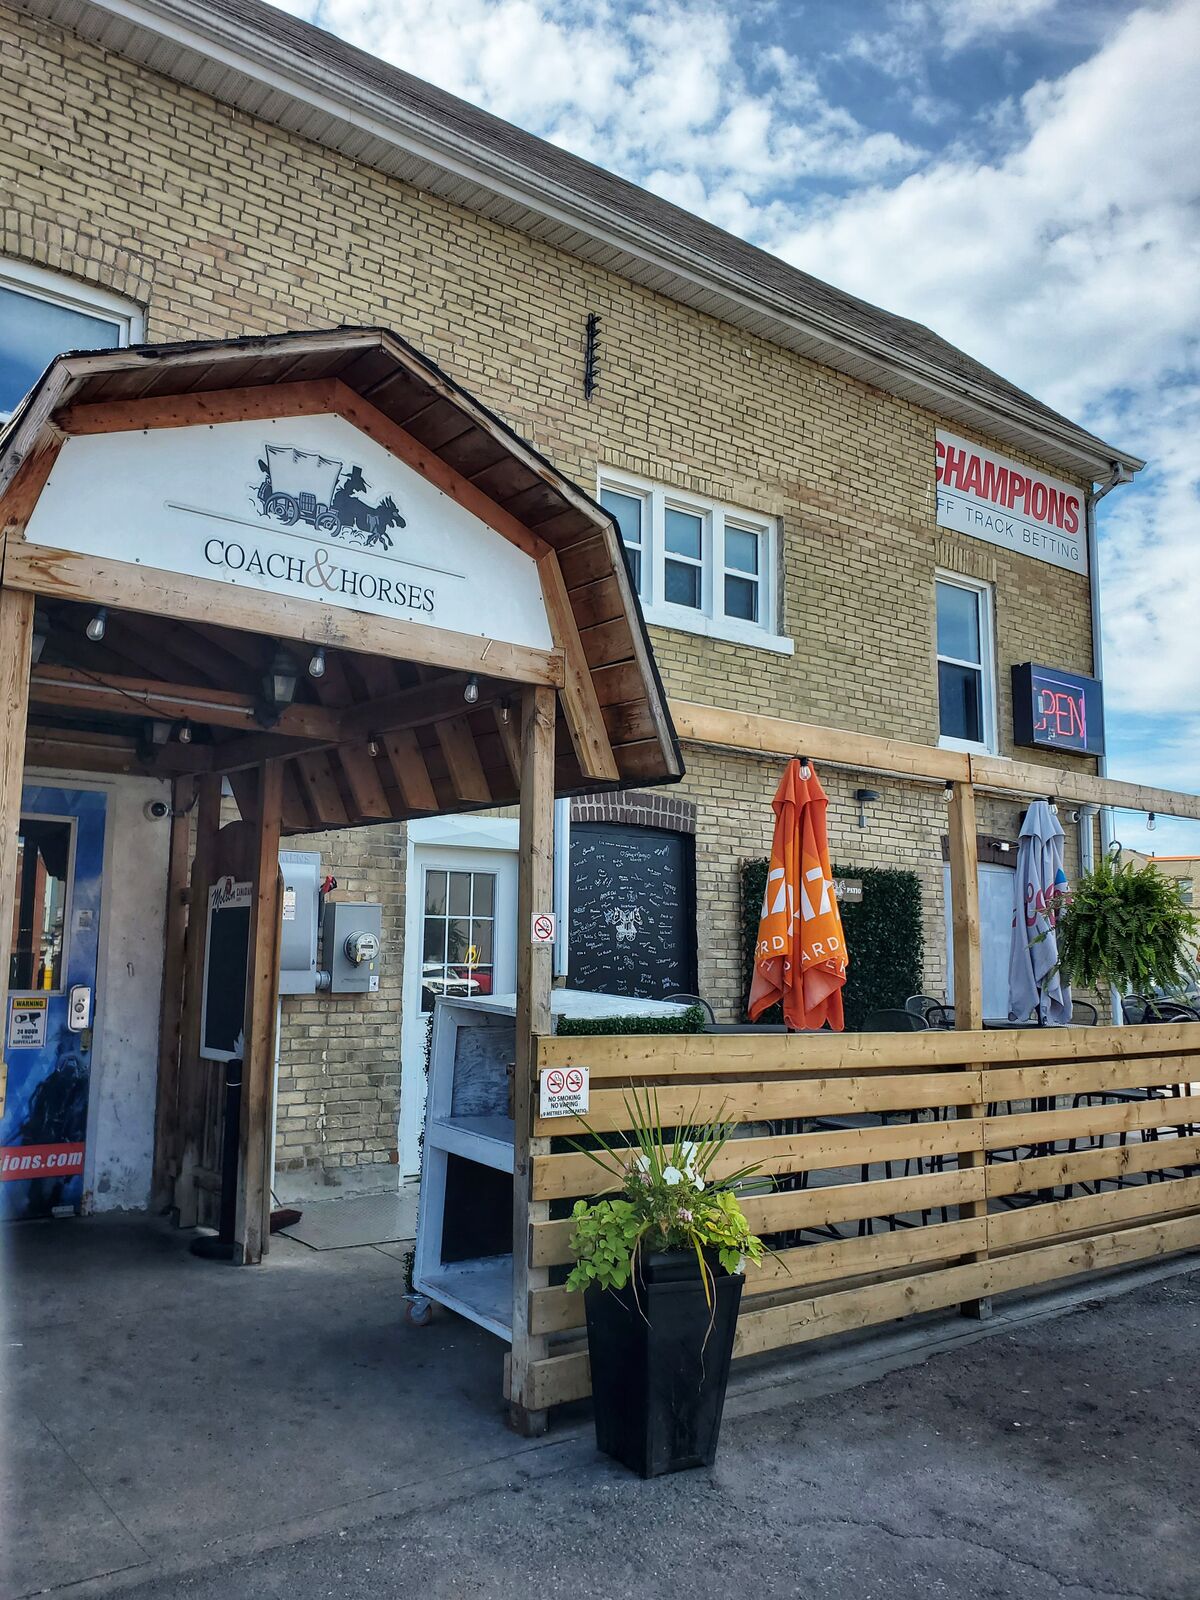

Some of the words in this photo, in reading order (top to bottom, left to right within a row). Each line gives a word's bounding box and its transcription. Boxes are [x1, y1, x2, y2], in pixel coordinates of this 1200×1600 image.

[965, 506, 1014, 538] TRACK
[1022, 528, 1079, 561] BETTING
[846, 887, 862, 895] PATIO
[557, 1094, 581, 1102] SMOKING
[2, 1152, 83, 1171] ions.com
